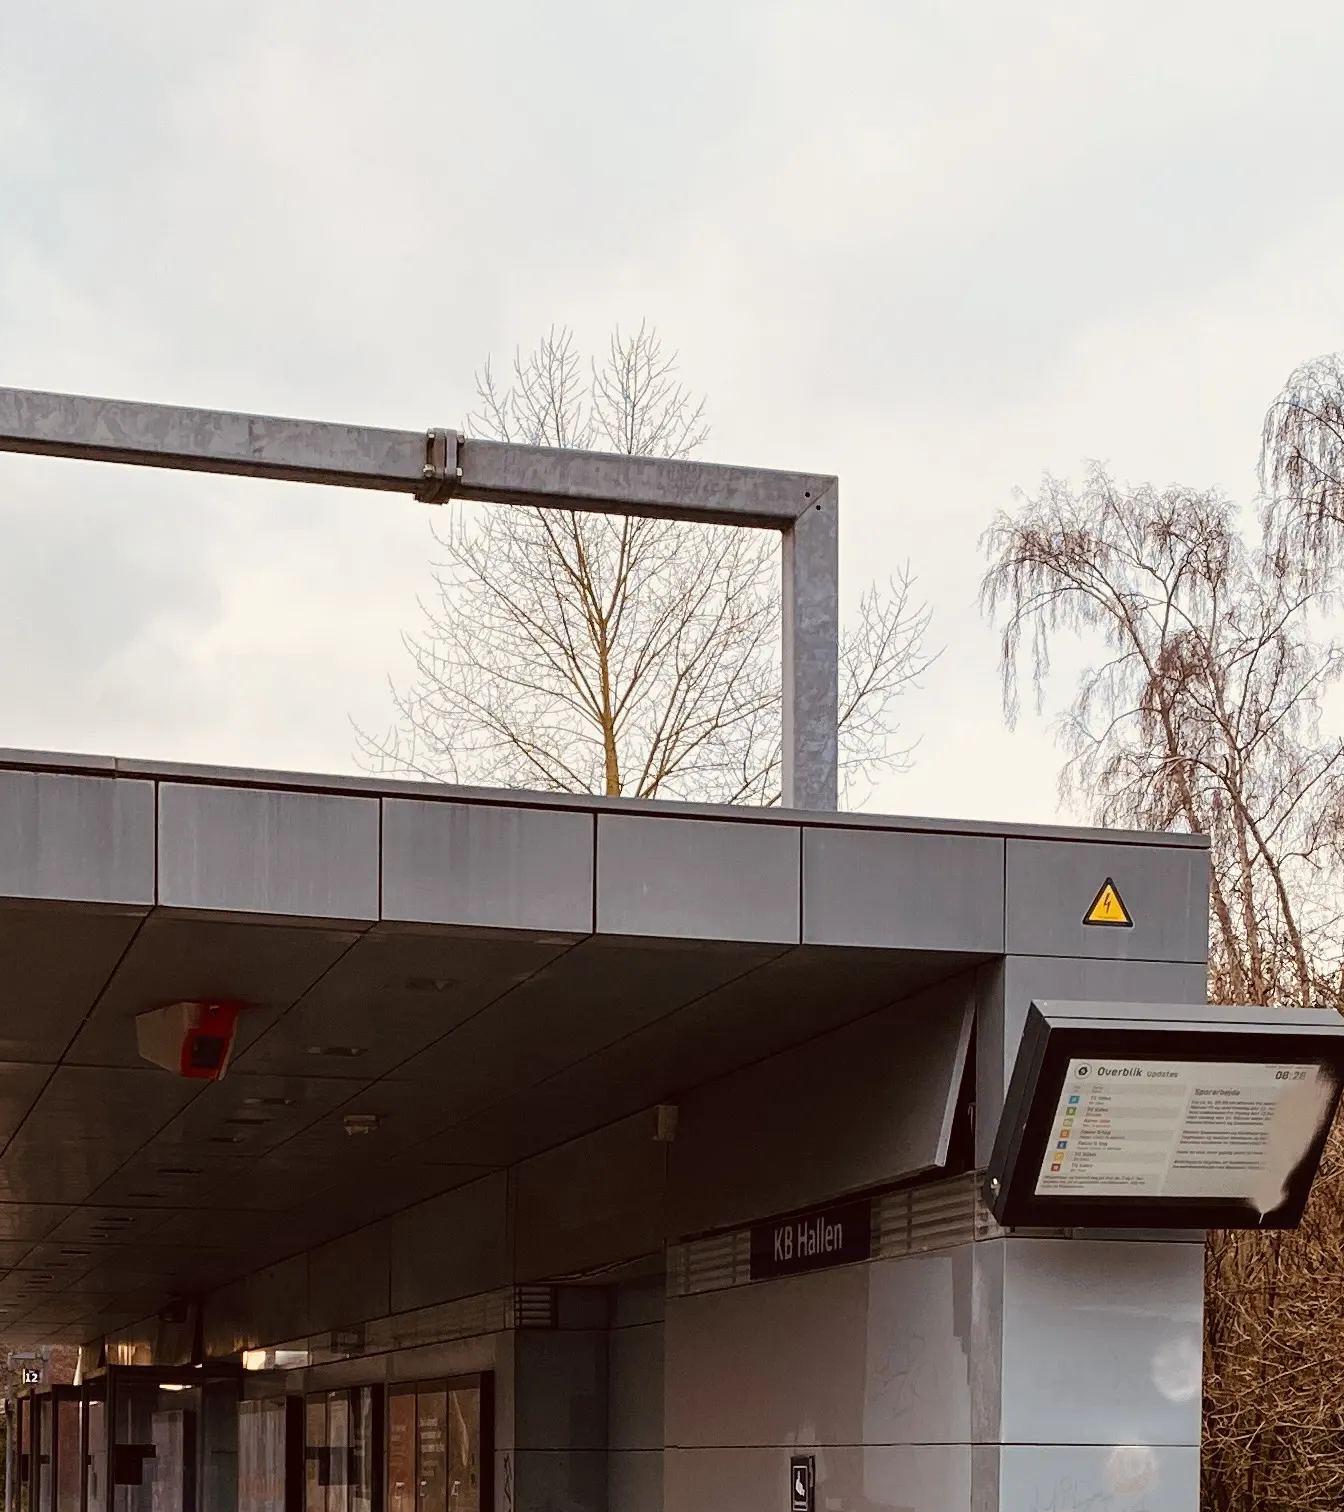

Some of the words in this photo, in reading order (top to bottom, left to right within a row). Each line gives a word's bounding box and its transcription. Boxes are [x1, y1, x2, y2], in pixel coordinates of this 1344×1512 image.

[1097, 1066, 1143, 1077] Overblik
[774, 1226, 793, 1261] KB
[797, 1217, 843, 1258] Hallen
[25, 1373, 38, 1382] 12
